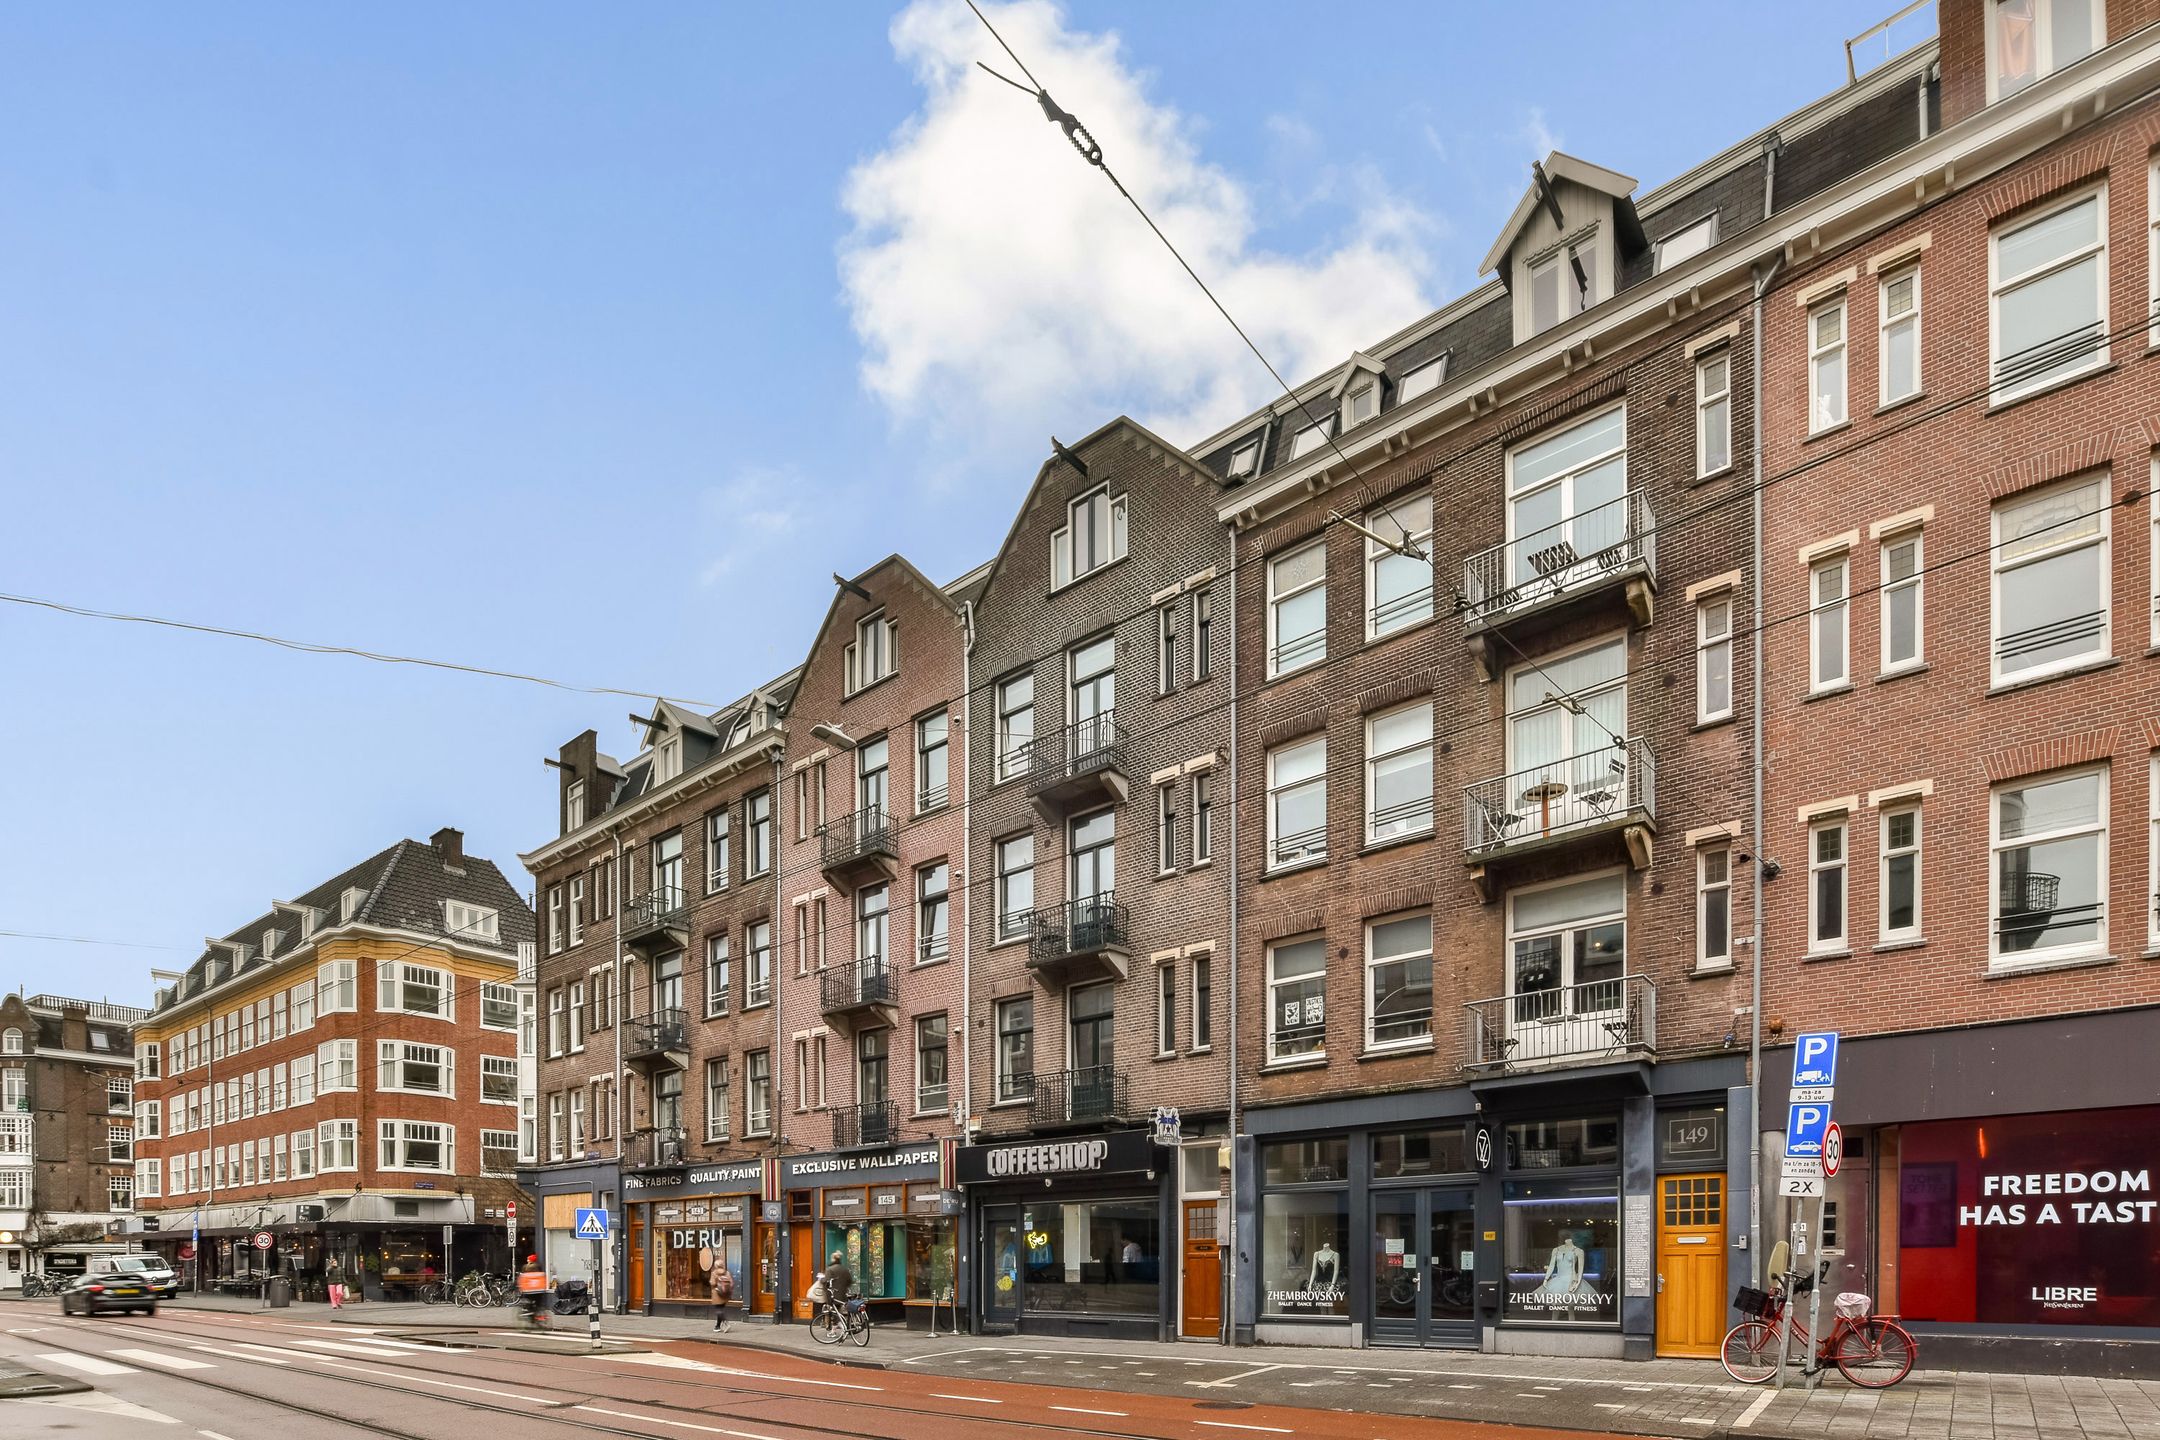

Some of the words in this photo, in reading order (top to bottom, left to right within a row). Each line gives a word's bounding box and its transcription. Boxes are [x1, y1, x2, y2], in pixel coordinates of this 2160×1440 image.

[1804, 1038, 1828, 1064] P
[1797, 1107, 1821, 1134] P
[1676, 1126, 1708, 1145] 149
[987, 1140, 1108, 1177] COFFEESHOP
[1827, 1139, 1839, 1160] 30
[792, 1159, 857, 1175] EXCLUSIVE
[859, 1151, 938, 1170] WALLPAPER
[625, 1178, 645, 1189] FINE
[645, 1175, 682, 1188] FABRICS
[690, 1168, 731, 1185] QUALITY
[732, 1167, 762, 1181] PAINT
[1984, 1169, 2150, 1196] FREEDOM
[1789, 1181, 1814, 1193] 2X
[880, 1196, 893, 1204] 145
[1960, 1204, 2026, 1226] HAS
[2036, 1203, 2061, 1224] A
[258, 1236, 269, 1245] 30
[673, 1231, 696, 1249] DE
[699, 1230, 723, 1249] RU
[1267, 1290, 1345, 1301] ZHEMBROVSKYY
[1509, 1293, 1613, 1305] ZHEMBROVSKYY
[2032, 1287, 2097, 1302] LIBRE
